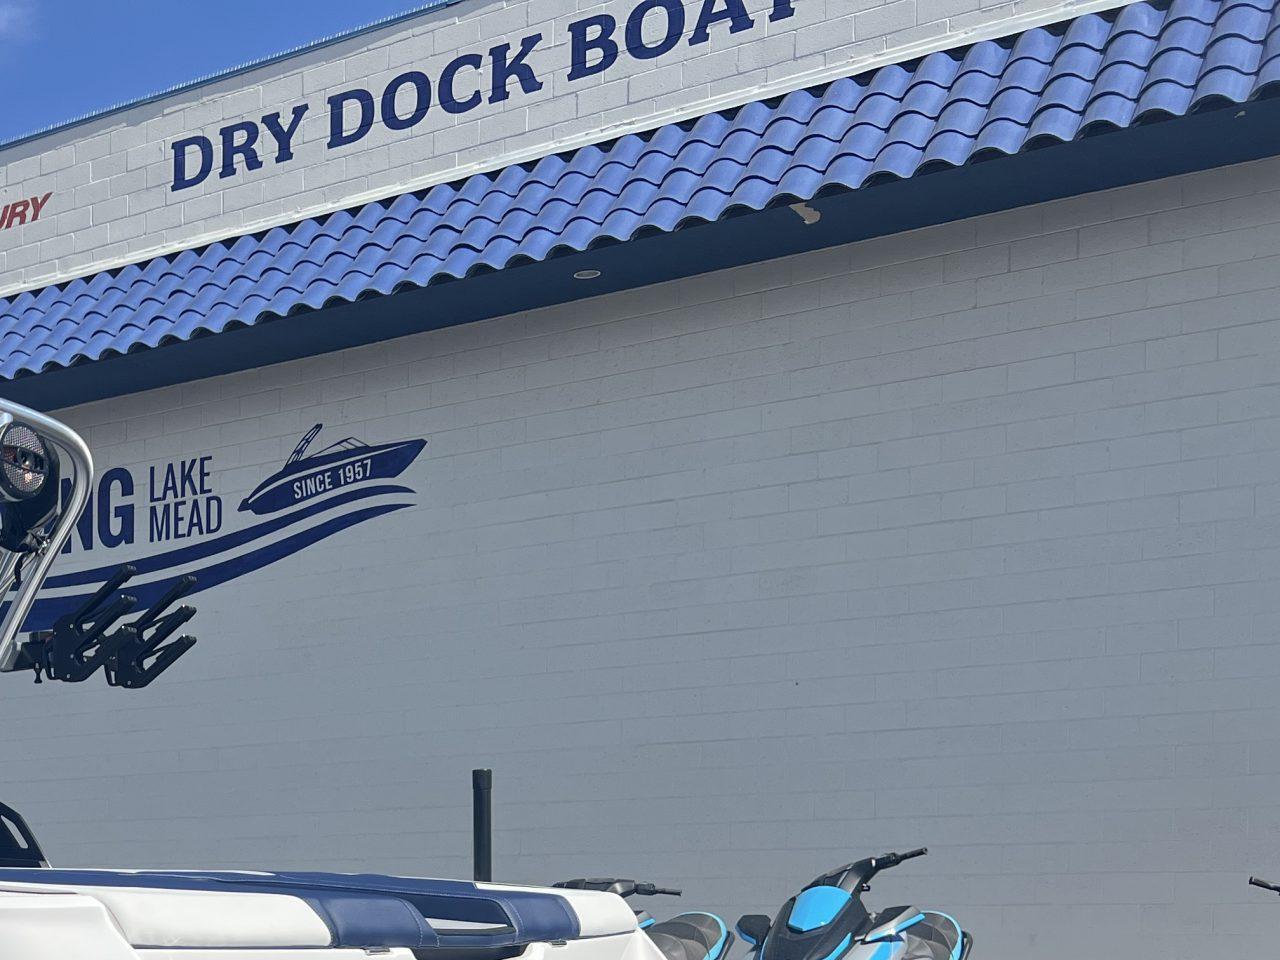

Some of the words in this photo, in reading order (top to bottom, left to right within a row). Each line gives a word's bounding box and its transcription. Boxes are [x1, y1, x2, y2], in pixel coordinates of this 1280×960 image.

[170, 104, 308, 192] DRY
[326, 33, 544, 149] DOCK
[149, 455, 213, 502] LAKE
[293, 471, 333, 499] SINCE
[338, 459, 372, 485] 1957
[149, 495, 223, 543] MEAD
